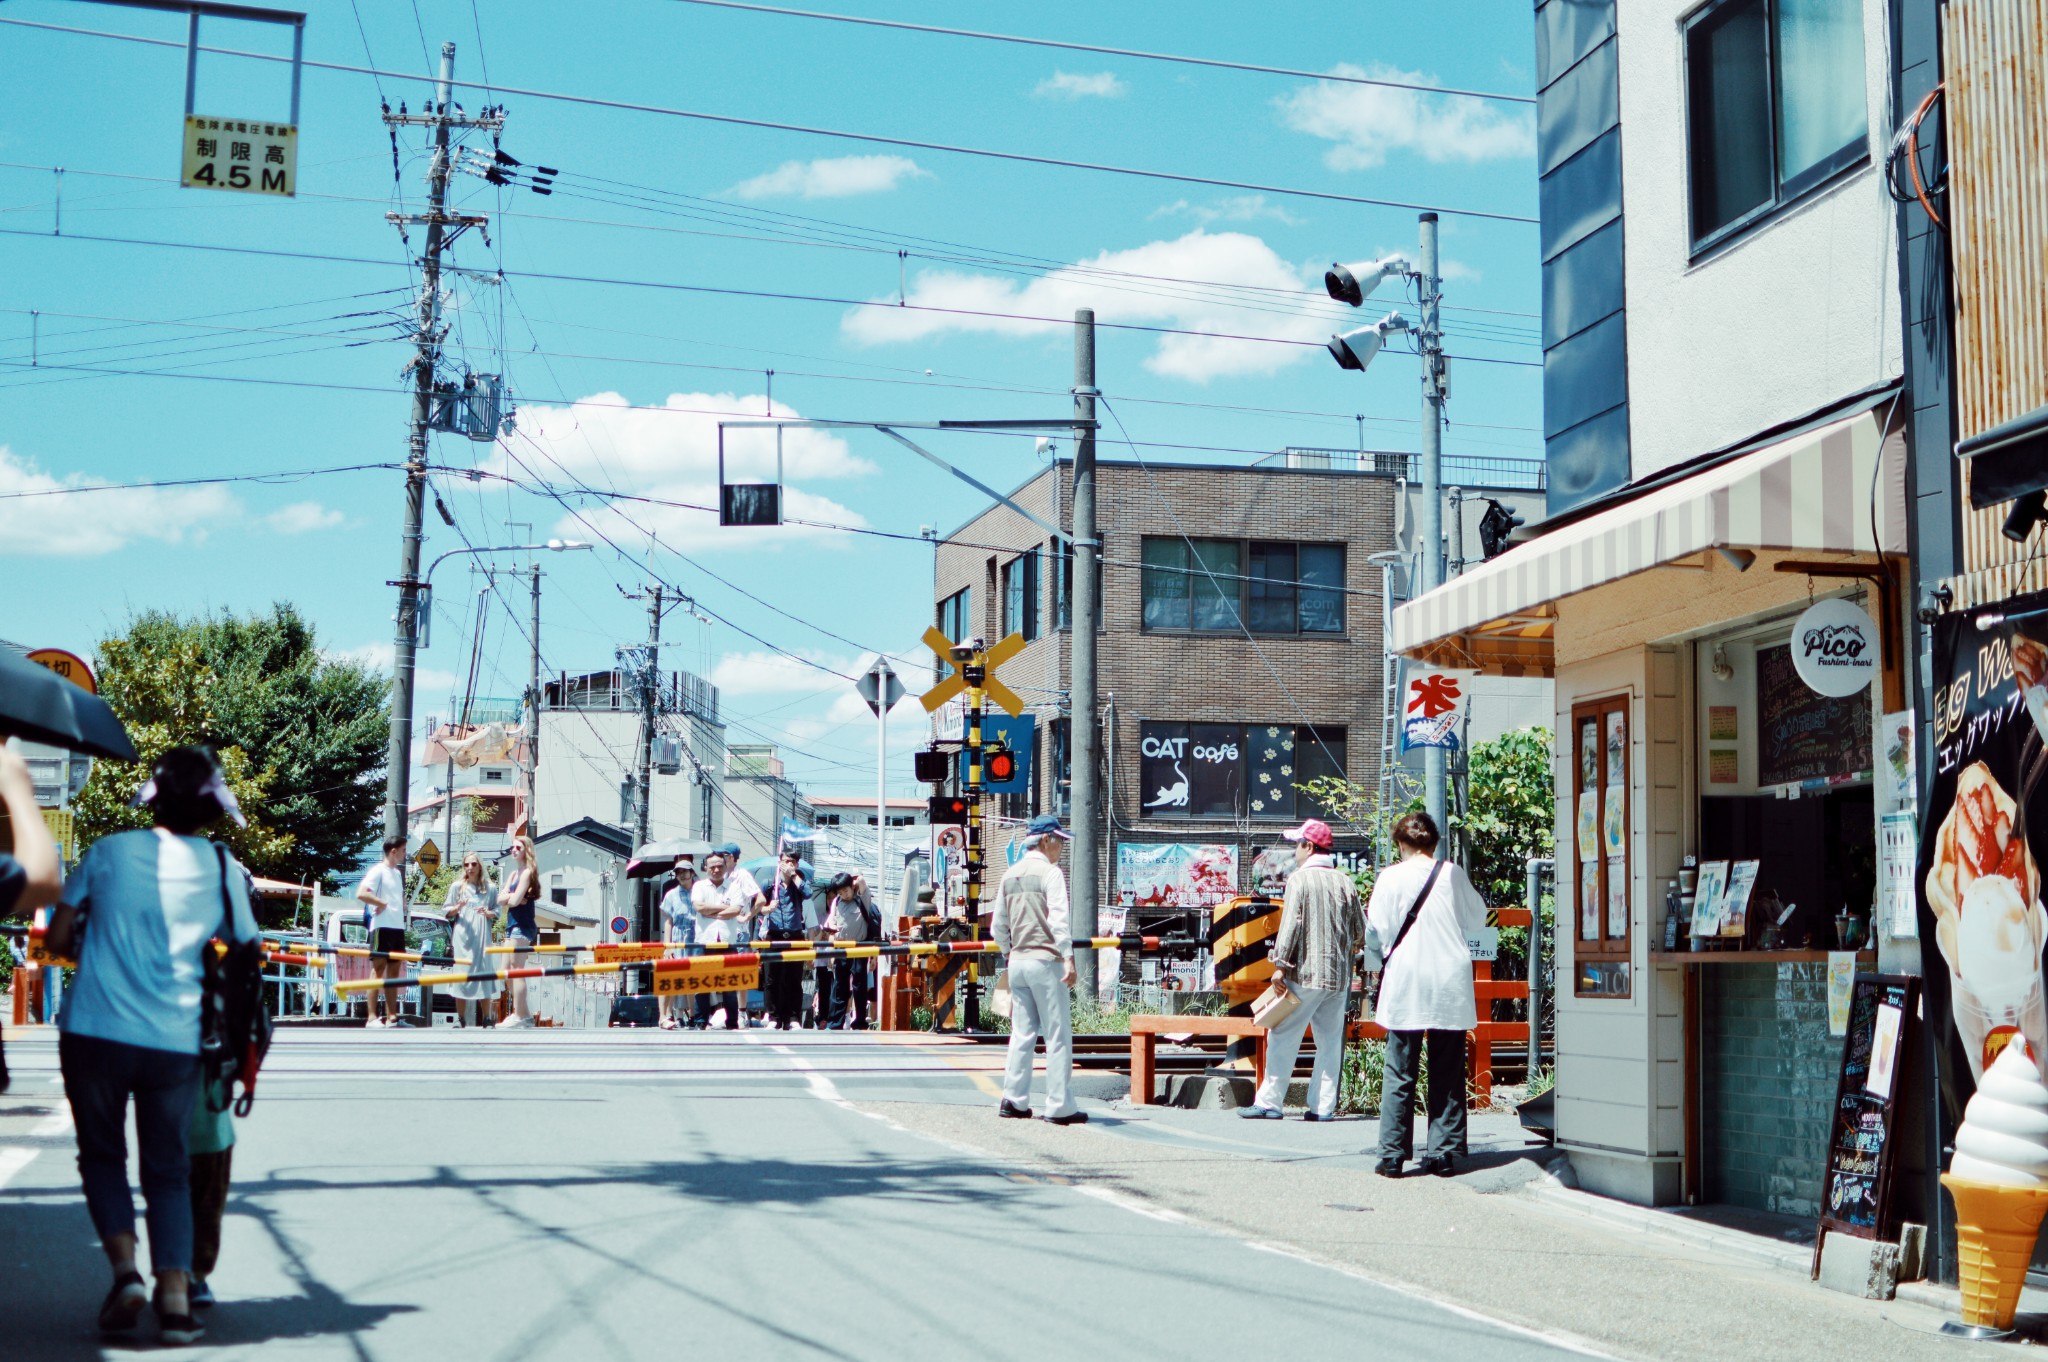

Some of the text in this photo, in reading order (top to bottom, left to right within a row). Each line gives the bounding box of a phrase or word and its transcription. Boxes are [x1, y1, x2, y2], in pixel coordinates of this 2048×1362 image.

[197, 138, 285, 165] 制限高
[1803, 626, 1866, 658] Pico
[1818, 657, 1873, 667] Fushimi-inari
[1407, 674, 1462, 719] 氷
[1938, 689, 2026, 775] エッグワッフ
[1141, 737, 1238, 764] CAT café
[1098, 912, 1124, 920] ental
[659, 973, 754, 991] おまちください
